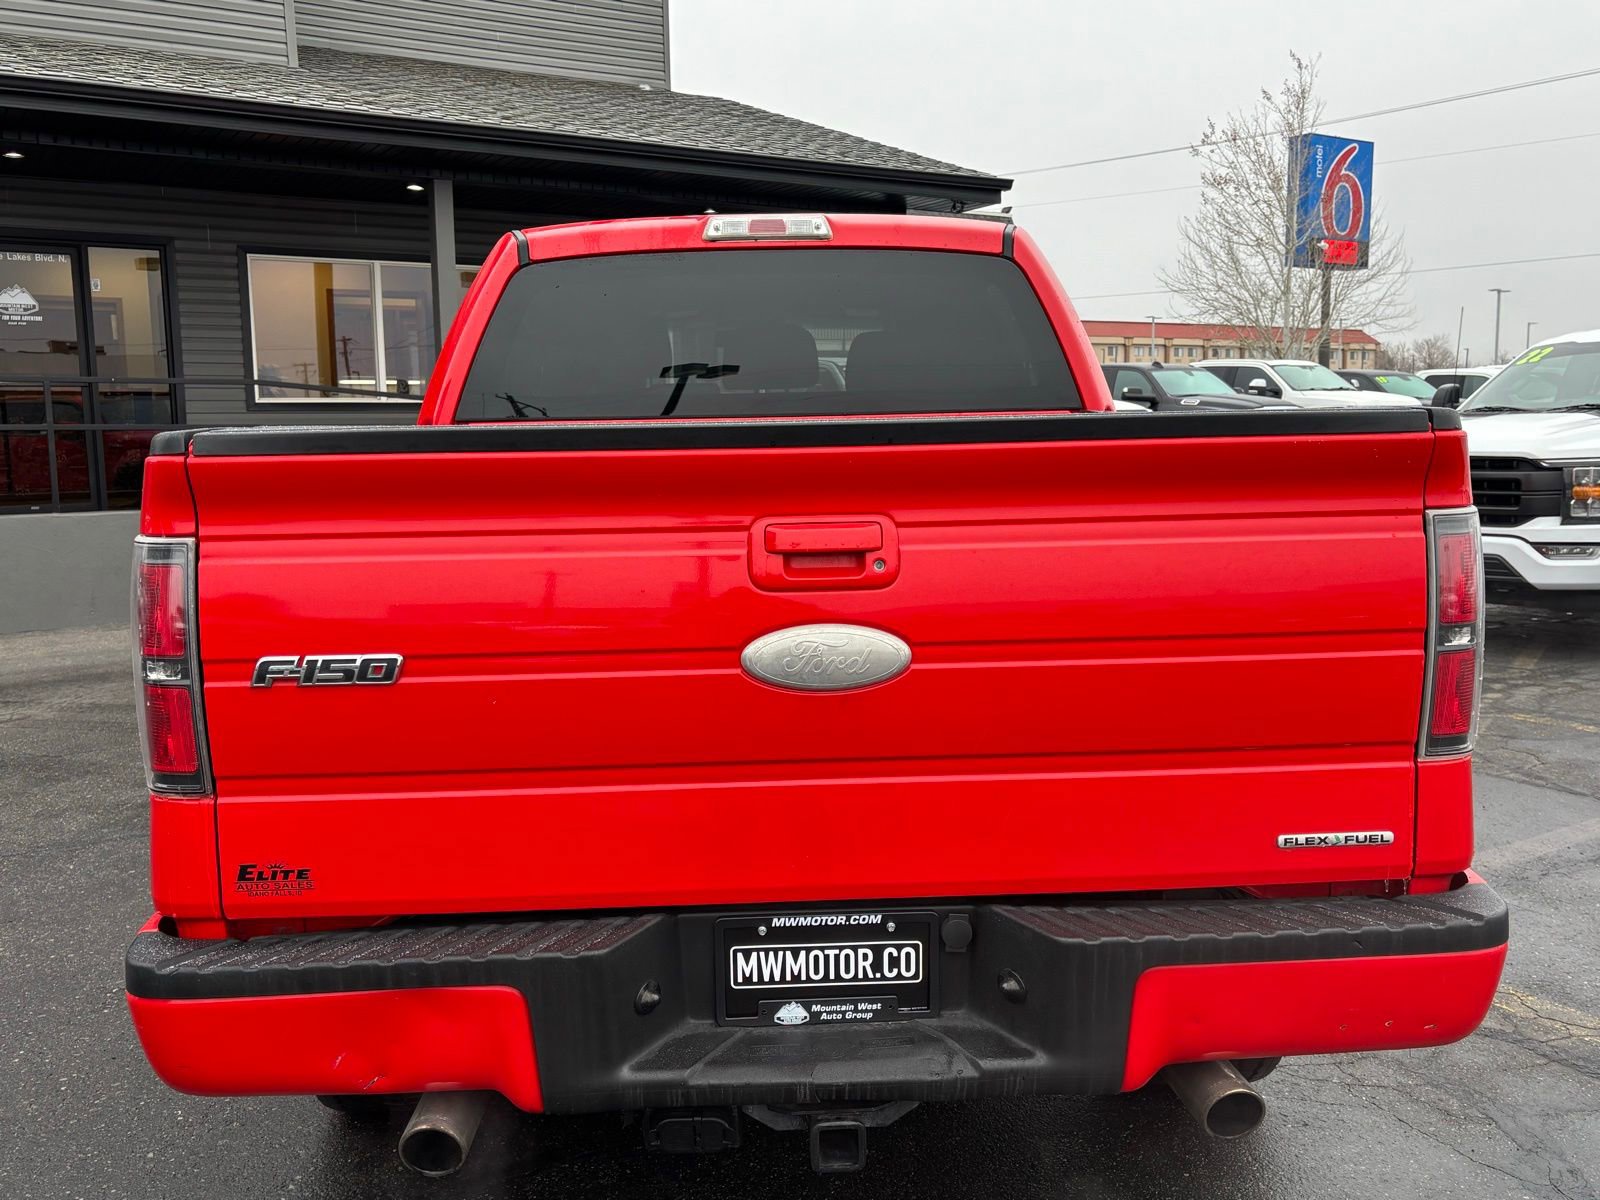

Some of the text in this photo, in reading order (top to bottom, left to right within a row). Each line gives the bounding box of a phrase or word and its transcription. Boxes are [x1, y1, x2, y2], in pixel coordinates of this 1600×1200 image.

[1316, 144, 1324, 178] motel
[1321, 143, 1364, 239] 6
[7, 253, 31, 261] Lakes
[35, 253, 55, 262] Blvd.
[58, 255, 67, 263] N.
[782, 638, 872, 675] Ford
[250, 653, 404, 688] F-150
[1283, 834, 1391, 847] FLEX FUEL
[237, 864, 311, 881] ELITE
[237, 881, 313, 891] AUTO SALES
[771, 914, 882, 928] MWMOTOR.COM
[736, 946, 917, 984] MWMOTOR.CO
[811, 1002, 882, 1013] Mountain West
[820, 1011, 874, 1021] Auto Group
